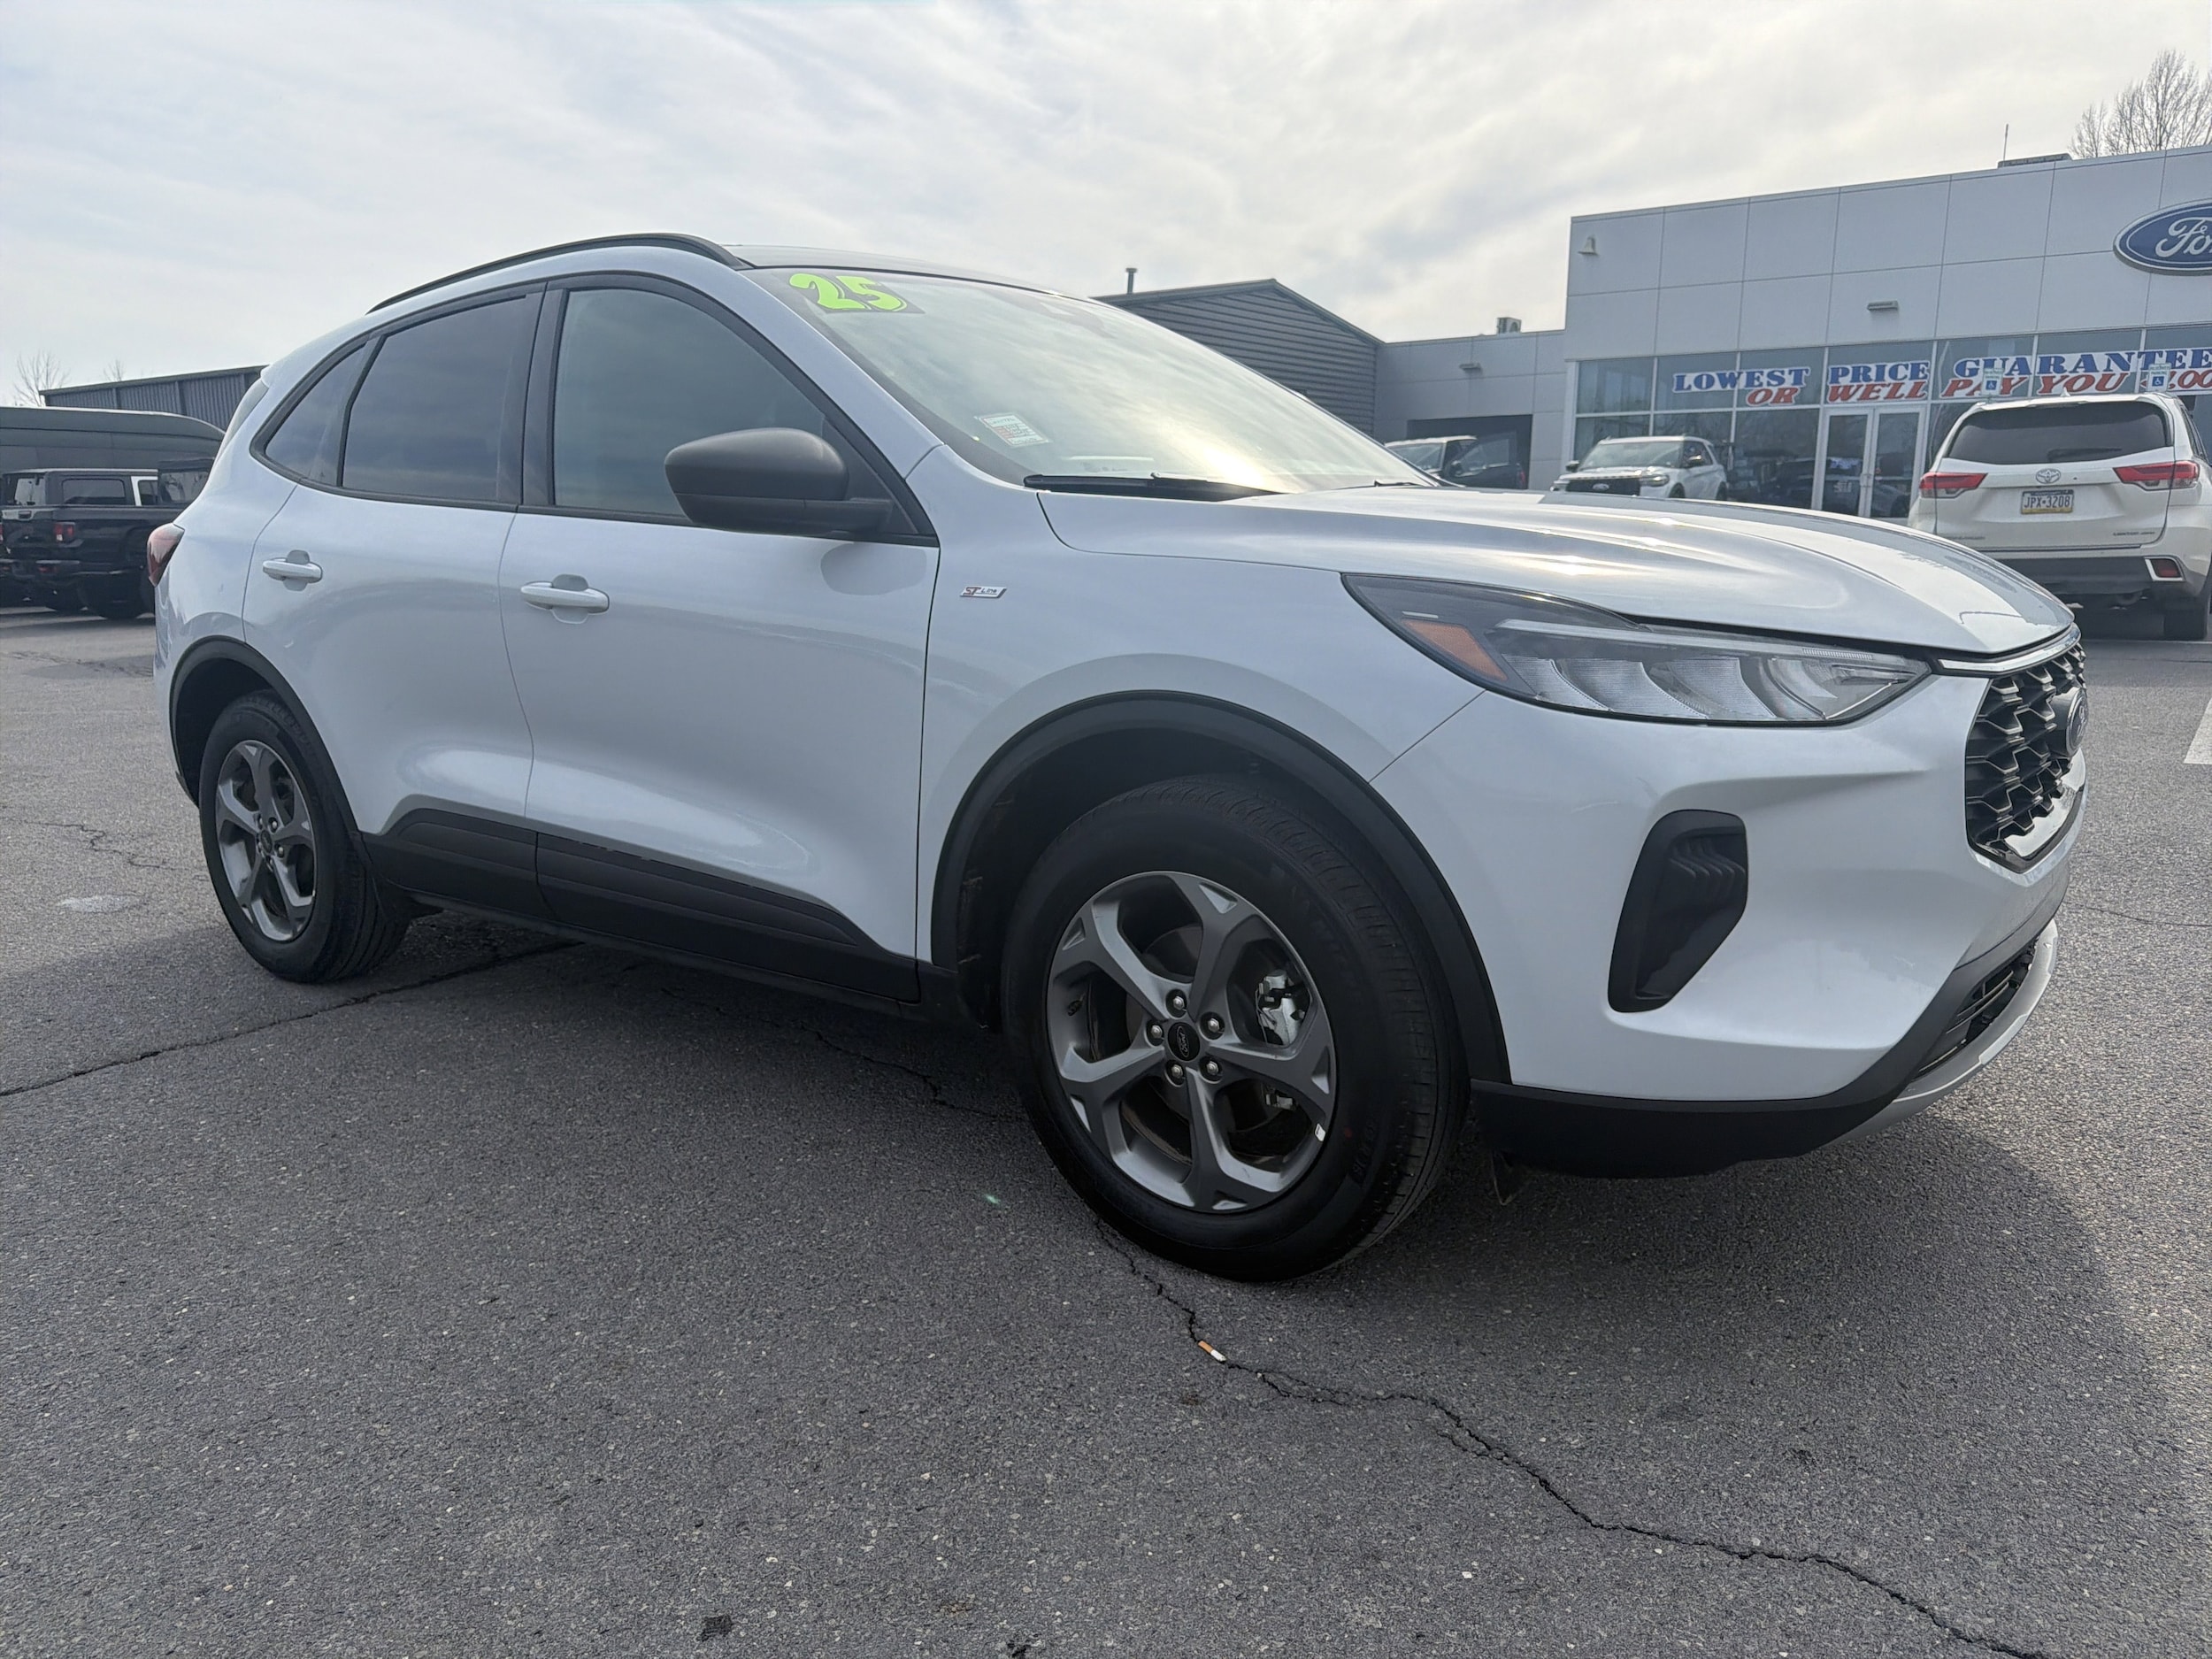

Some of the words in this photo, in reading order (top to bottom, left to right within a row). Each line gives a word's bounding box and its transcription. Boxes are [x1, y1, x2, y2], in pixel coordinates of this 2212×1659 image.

[2155, 217, 2212, 257] Fo
[789, 273, 908, 311] 25
[1674, 368, 1810, 392] LOWEST
[1829, 362, 1931, 384] PRICE
[1955, 349, 2212, 379] GUARANTEE
[1747, 388, 1800, 405] OR
[2038, 373, 2130, 395] YOU
